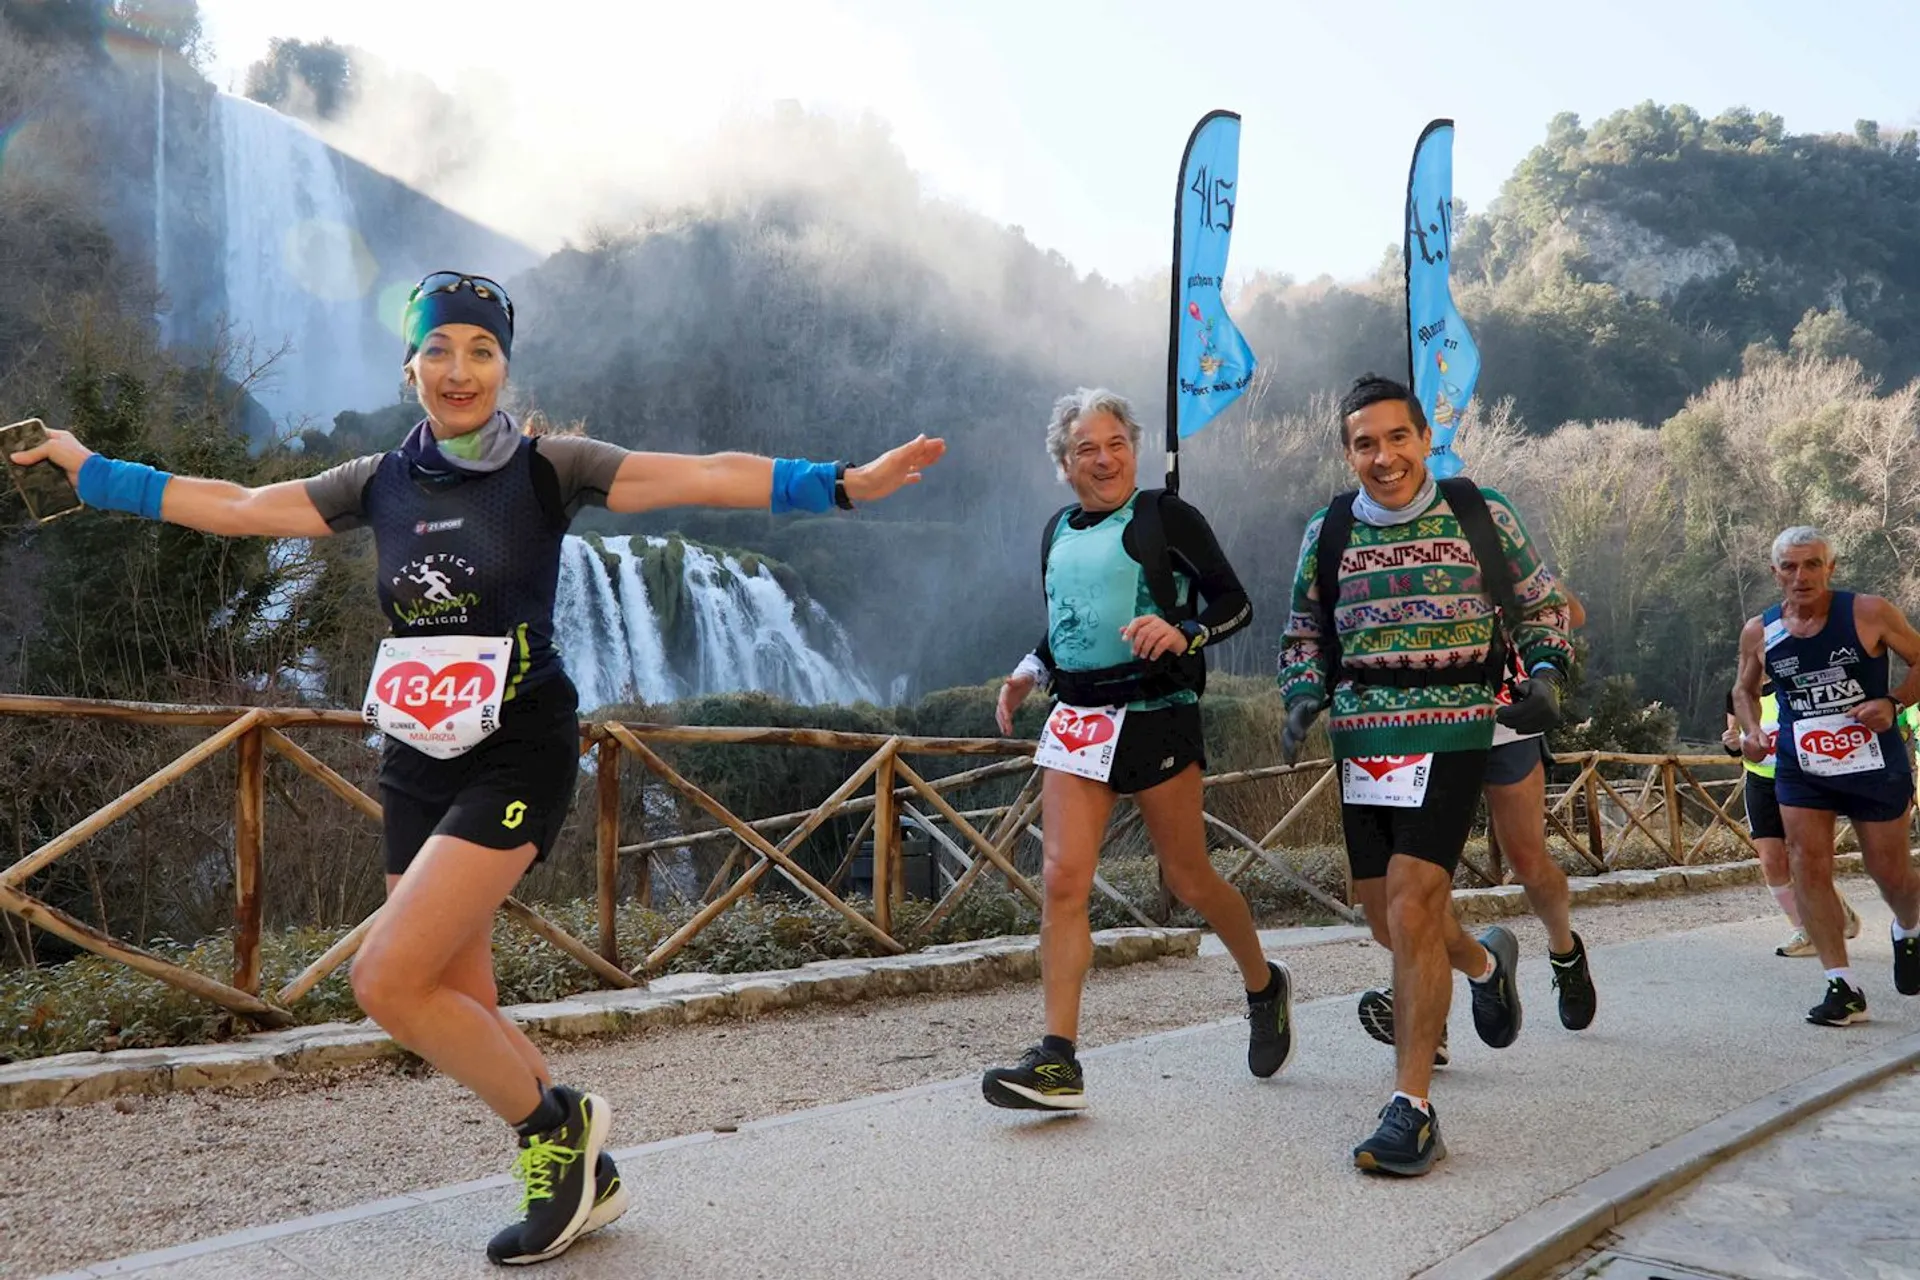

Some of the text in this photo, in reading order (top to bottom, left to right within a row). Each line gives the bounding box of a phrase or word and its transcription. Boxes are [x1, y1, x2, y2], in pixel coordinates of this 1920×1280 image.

[392, 553, 475, 586] ATLETICA
[384, 674, 484, 709] 1344
[408, 732, 458, 743] MAURIZIA
[1055, 714, 1099, 742] 541
[1805, 730, 1865, 754] 1639
